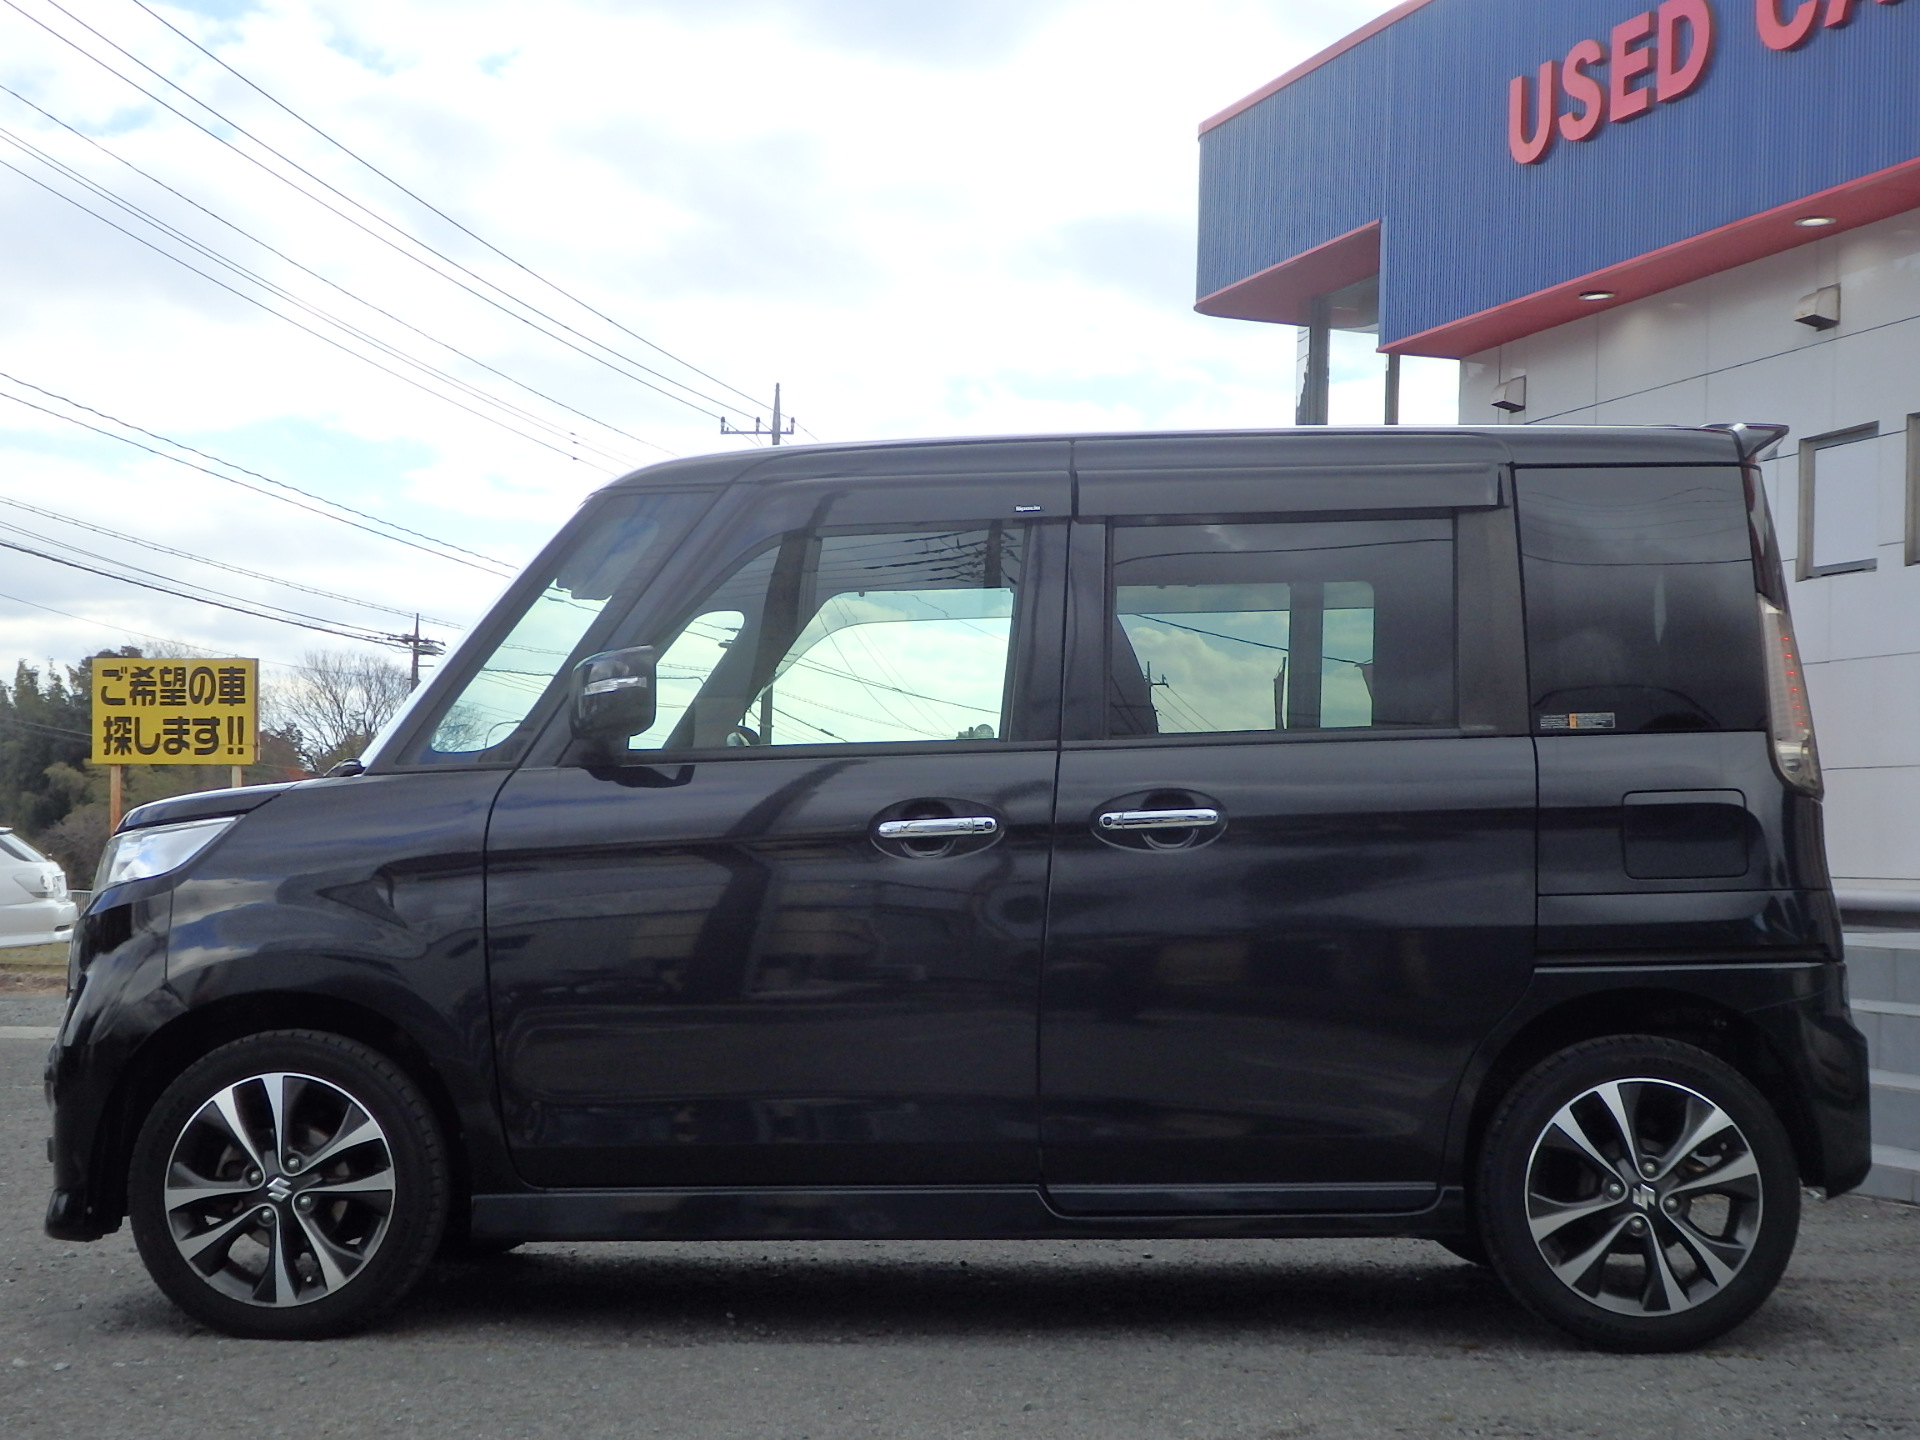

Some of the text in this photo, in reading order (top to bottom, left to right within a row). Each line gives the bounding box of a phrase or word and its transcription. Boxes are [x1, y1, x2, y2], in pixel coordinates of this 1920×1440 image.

[1508, 0, 1713, 165] USED
[100, 666, 246, 706] ご希望の車
[103, 715, 244, 755] 探します!!
